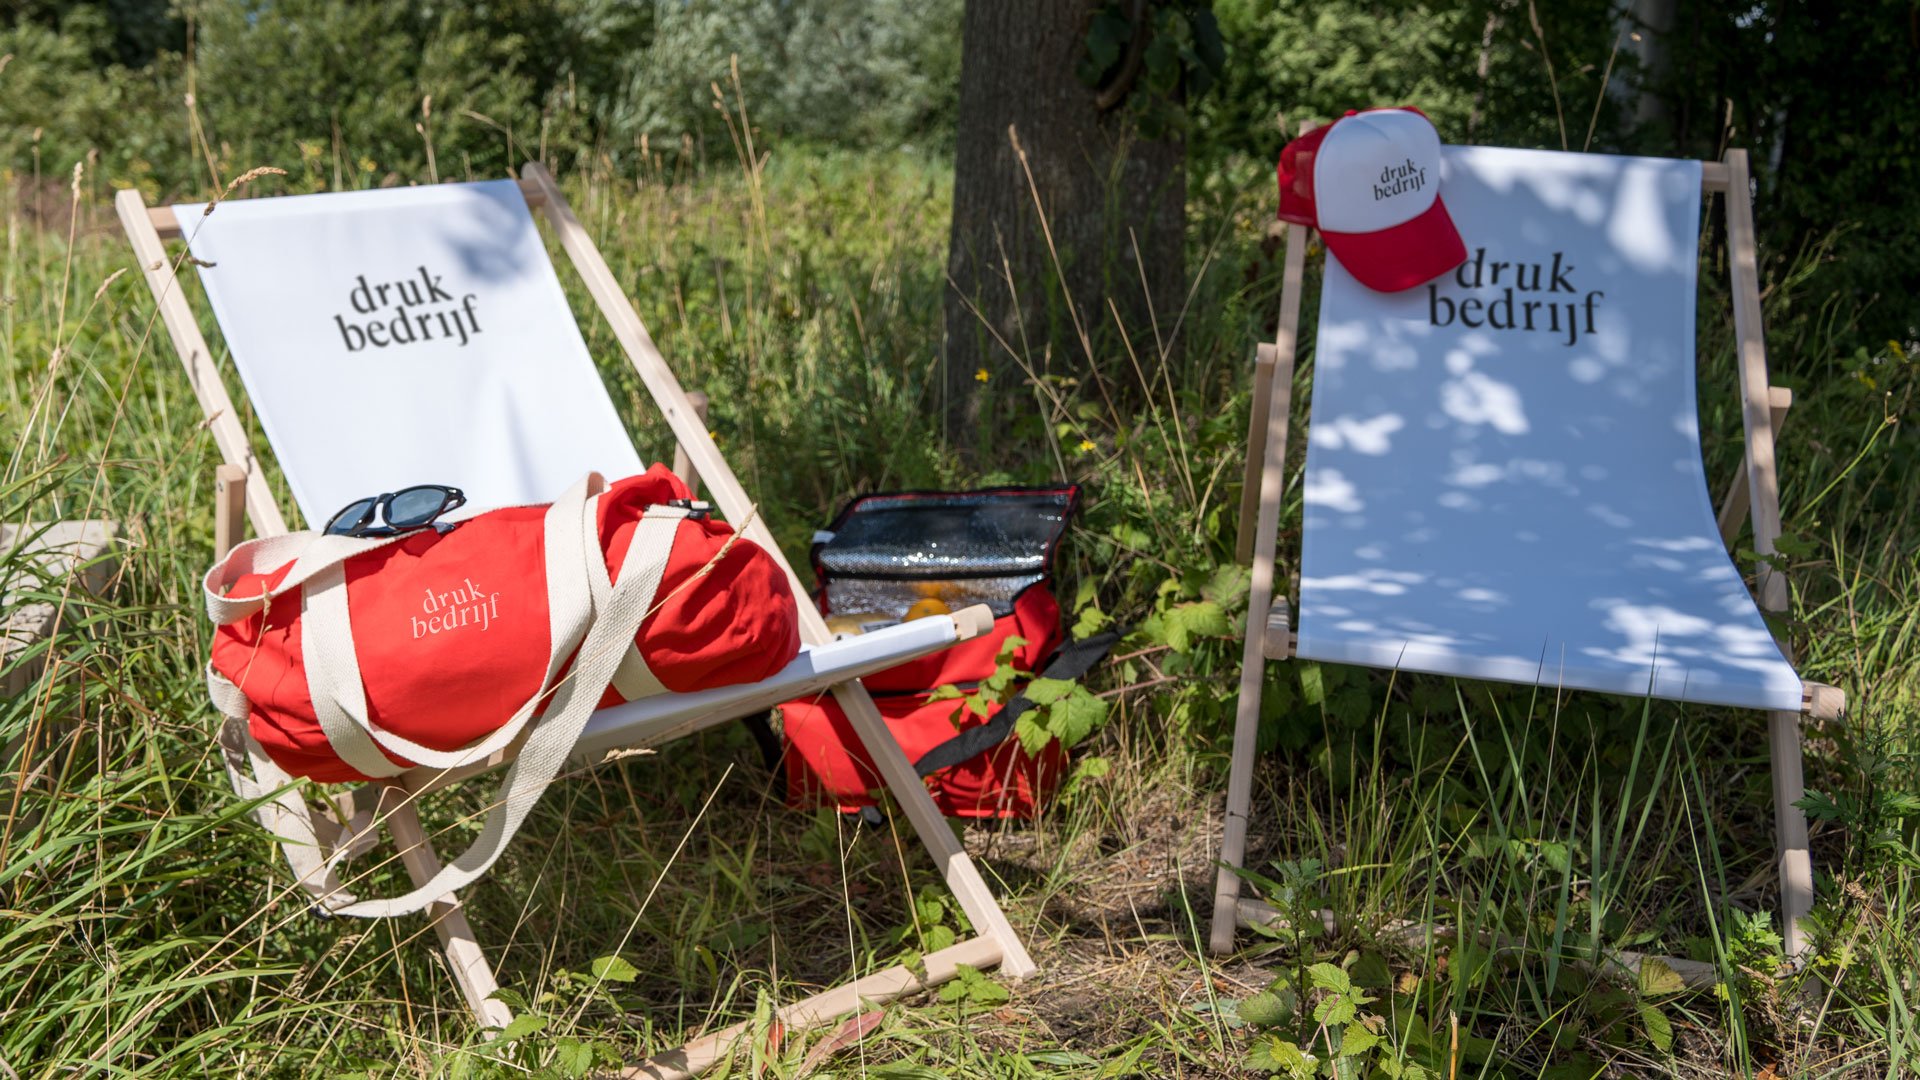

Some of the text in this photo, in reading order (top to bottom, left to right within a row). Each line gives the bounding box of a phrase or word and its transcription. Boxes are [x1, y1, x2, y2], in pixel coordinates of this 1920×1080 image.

[1373, 167, 1426, 201] bedrijf
[1381, 158, 1418, 184] druk
[350, 265, 454, 315] druk
[1455, 247, 1577, 294] druk
[333, 293, 483, 352] bedrijf
[1427, 283, 1605, 347] bedrijf
[410, 592, 500, 639] bedrijf
[423, 578, 486, 614] druk
